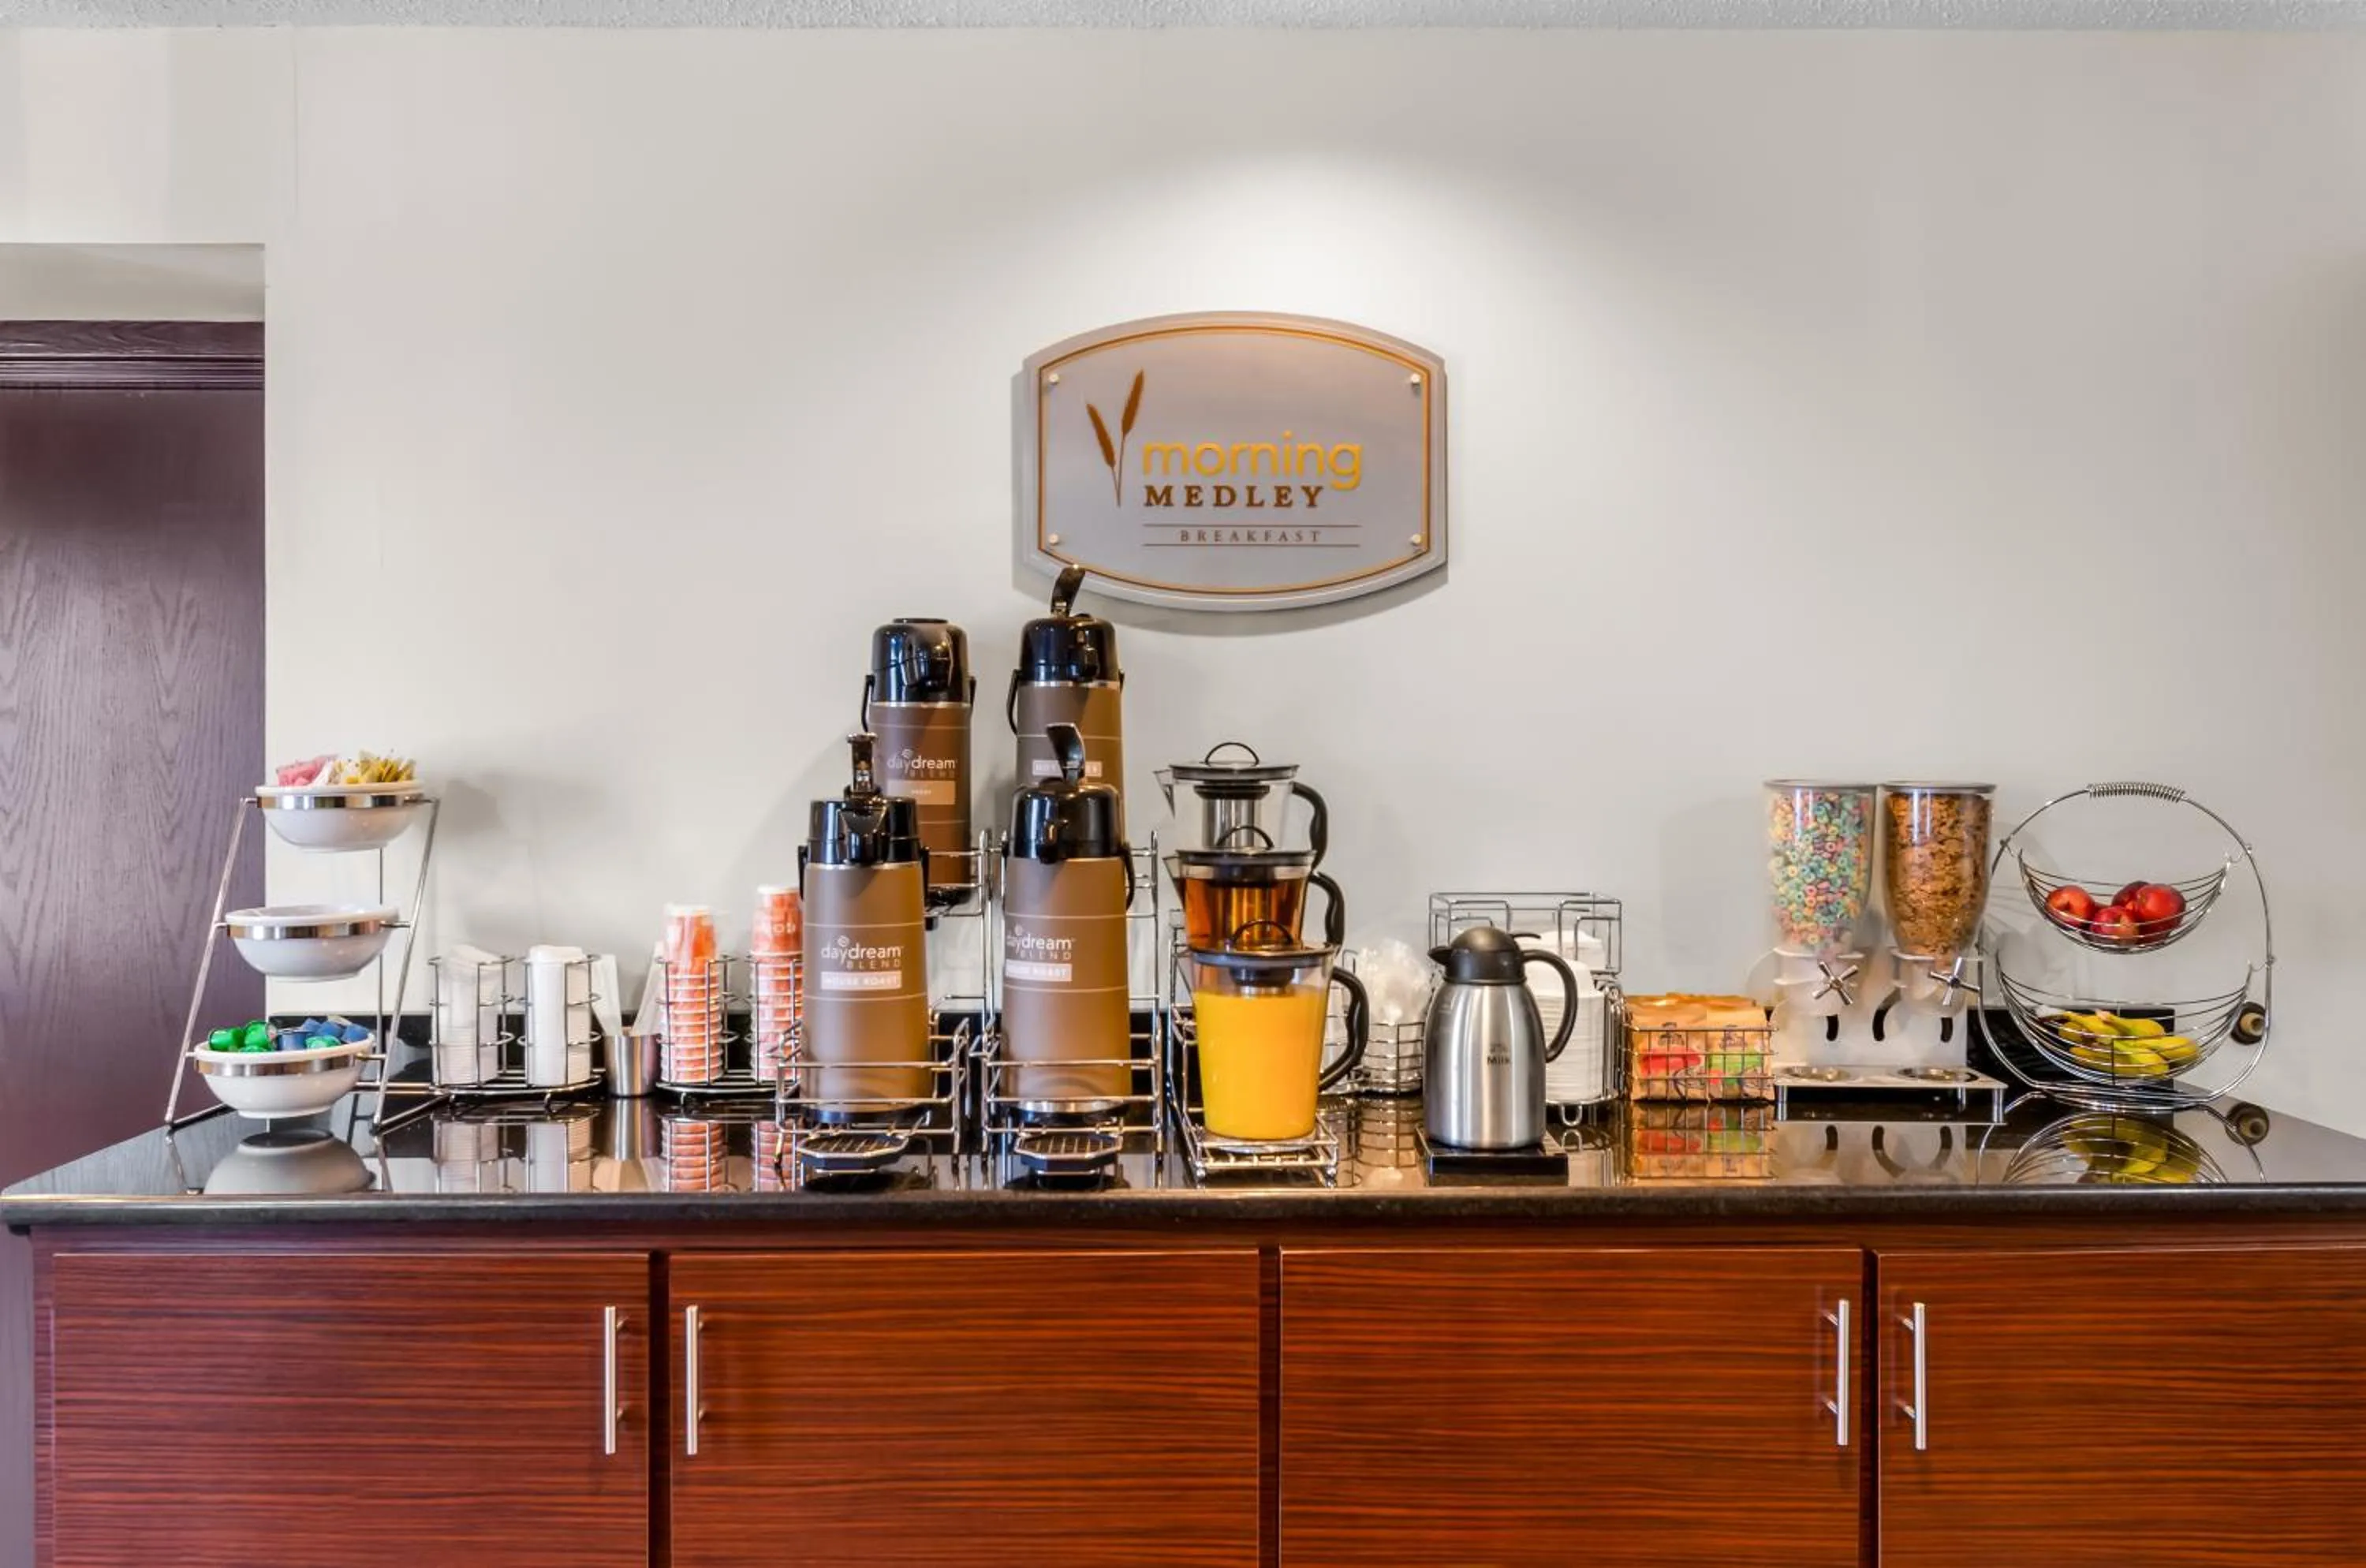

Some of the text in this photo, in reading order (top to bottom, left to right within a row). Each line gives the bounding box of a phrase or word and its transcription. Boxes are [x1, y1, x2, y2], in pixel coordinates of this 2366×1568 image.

[1144, 431, 1362, 490] morning
[1144, 485, 1323, 508] MEDLEY
[1181, 530, 1321, 543] BREAKFAST
[887, 754, 955, 774] daydream
[821, 943, 901, 965] daydream
[846, 959, 901, 969] BLEND
[1487, 1056, 1510, 1065] Milk
